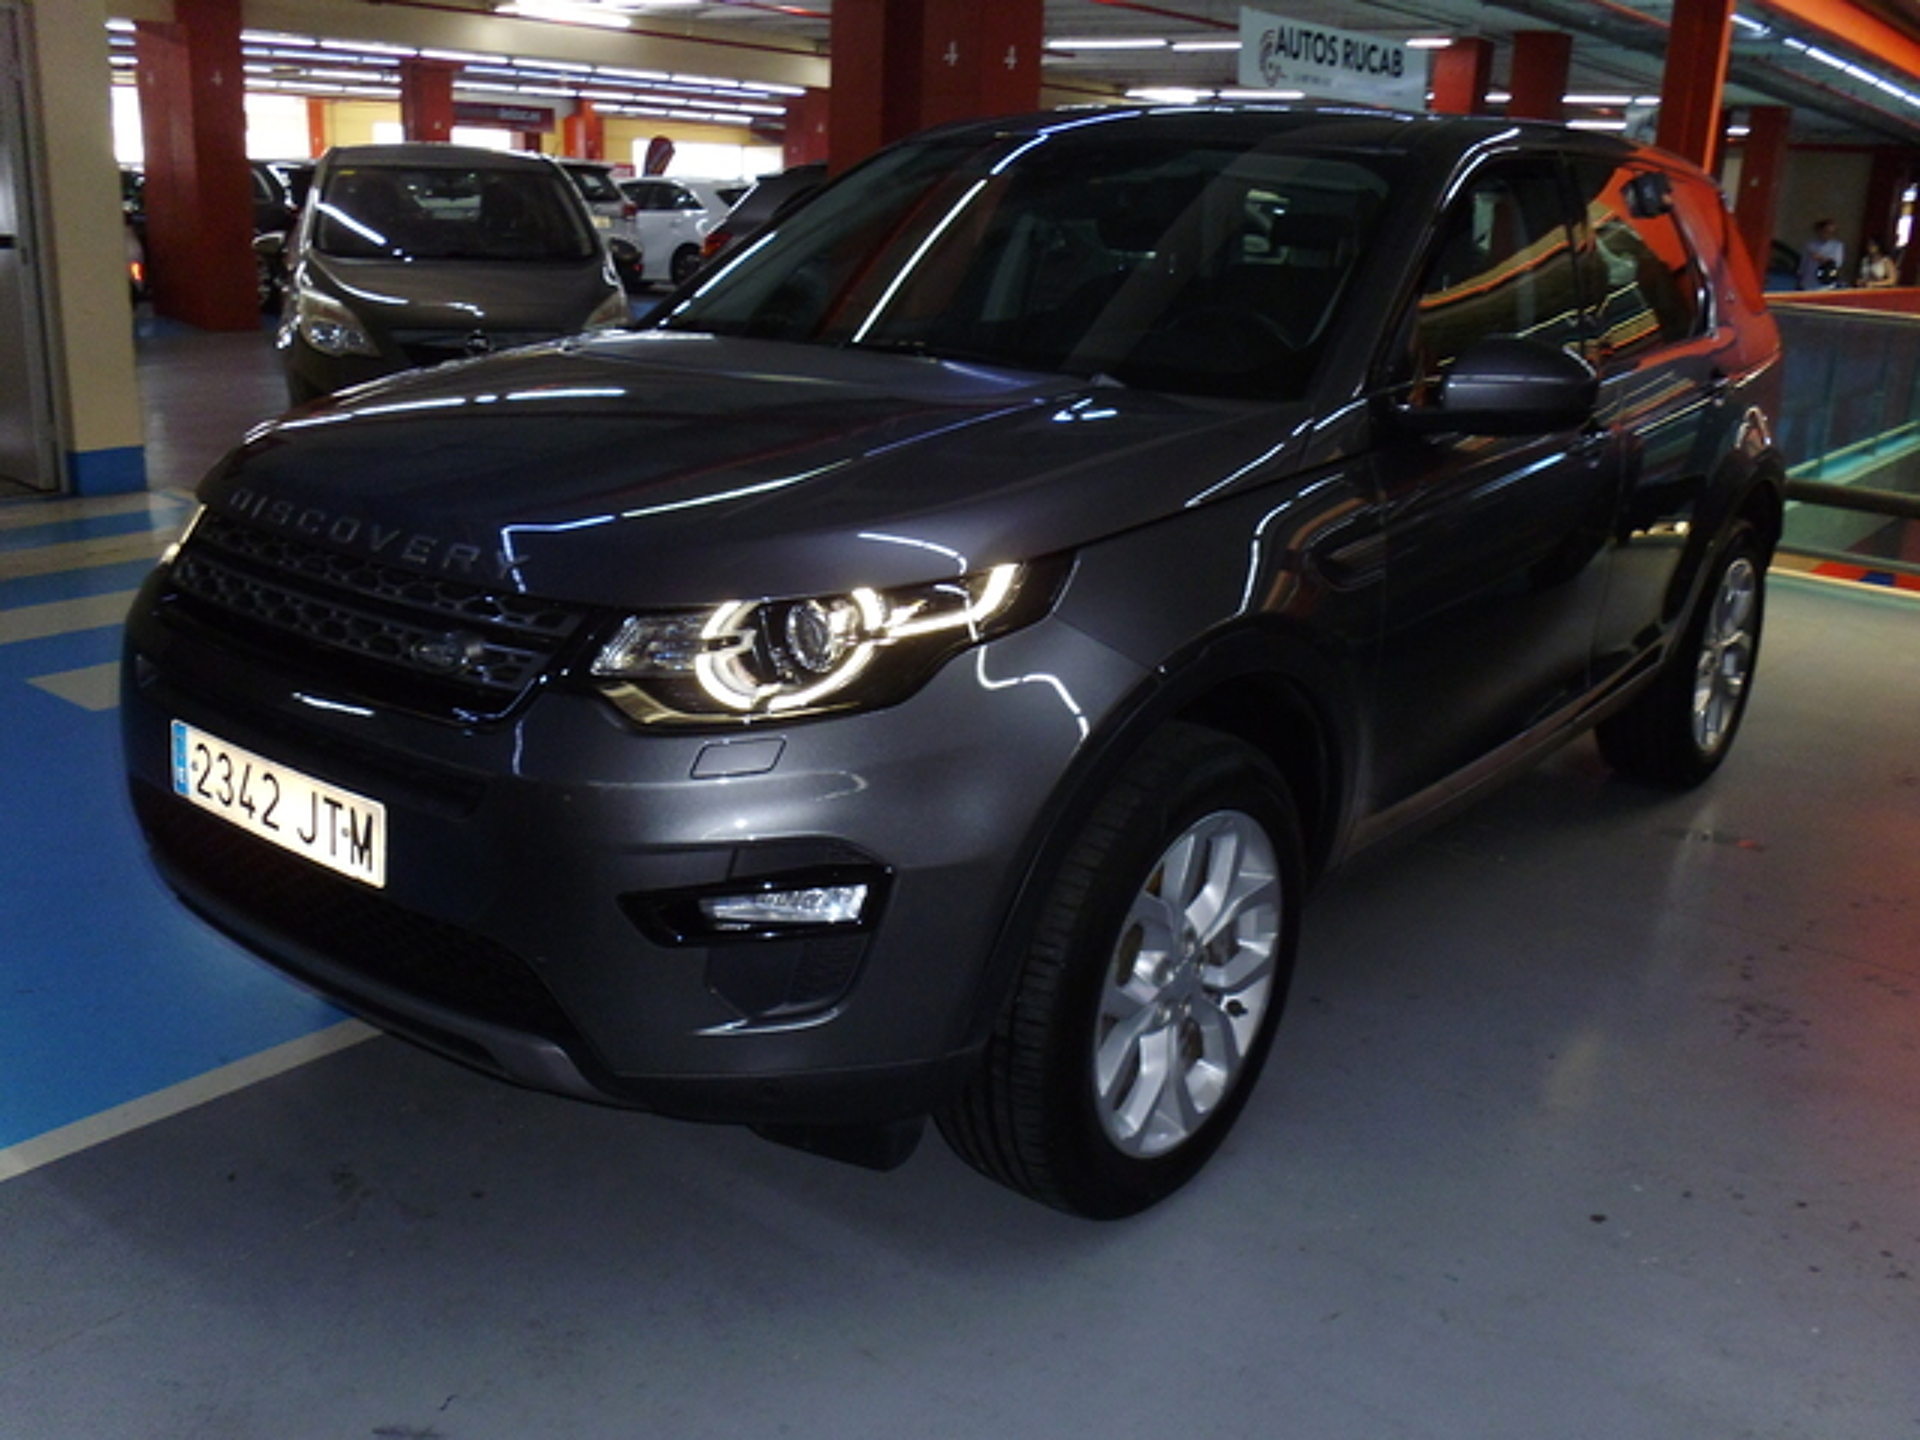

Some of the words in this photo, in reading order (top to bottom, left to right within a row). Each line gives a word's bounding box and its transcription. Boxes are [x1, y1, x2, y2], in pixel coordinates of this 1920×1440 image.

[1274, 26, 1339, 67] AUTOS
[1341, 39, 1404, 78] RUCAB
[195, 742, 281, 831] 2342
[297, 791, 374, 873] JTM
